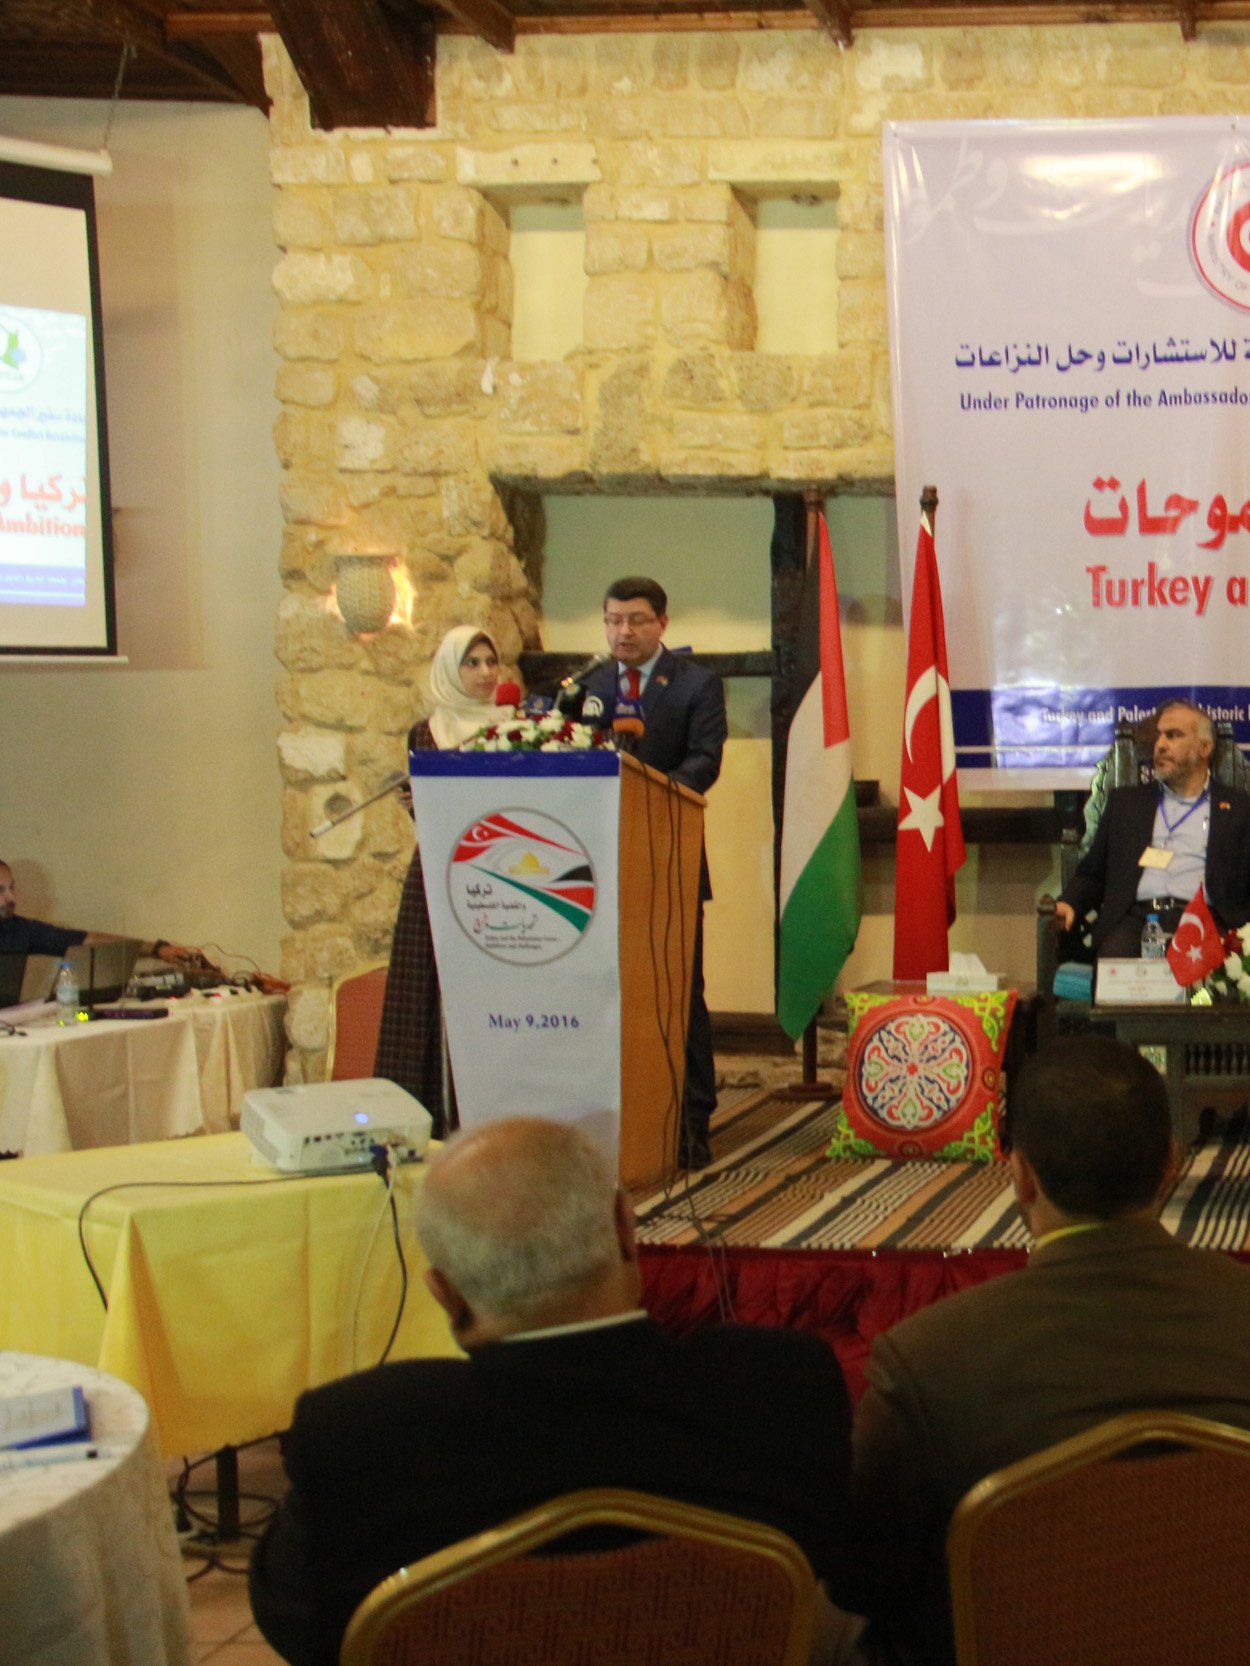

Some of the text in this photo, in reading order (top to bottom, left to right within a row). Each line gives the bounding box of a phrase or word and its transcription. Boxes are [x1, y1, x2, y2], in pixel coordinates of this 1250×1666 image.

[955, 343, 1049, 374] النزاعات
[1056, 344, 1106, 373] وحل
[1112, 337, 1237, 371] للاستشارات
[960, 391, 1009, 411] Under
[1016, 391, 1099, 414] Patronage
[1105, 389, 1120, 408] of
[1126, 388, 1152, 407] the
[1085, 561, 1214, 617] Turkey
[489, 1013, 520, 1033] May
